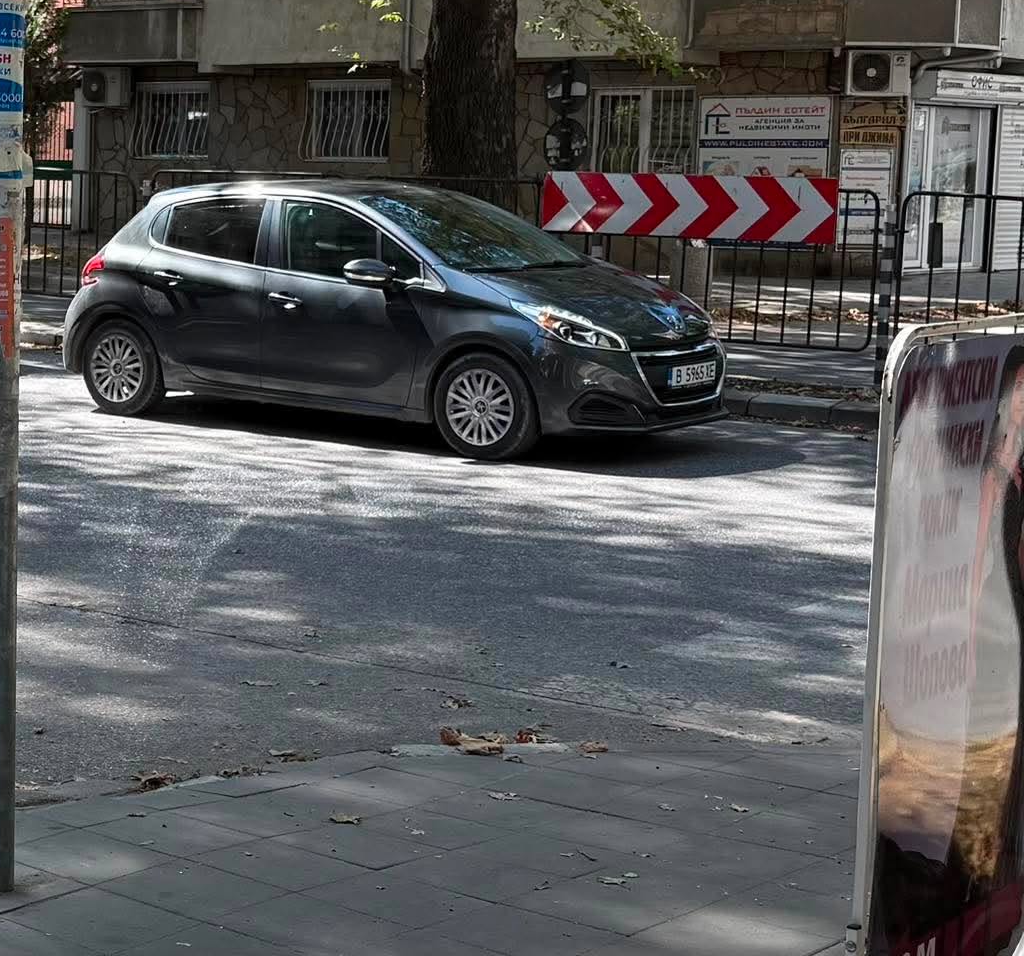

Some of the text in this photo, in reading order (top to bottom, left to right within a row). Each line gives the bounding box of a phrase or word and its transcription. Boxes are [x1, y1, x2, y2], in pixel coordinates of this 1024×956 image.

[843, 131, 860, 143] ПРИ
[676, 369, 682, 384] B
[686, 364, 705, 383] 5965
